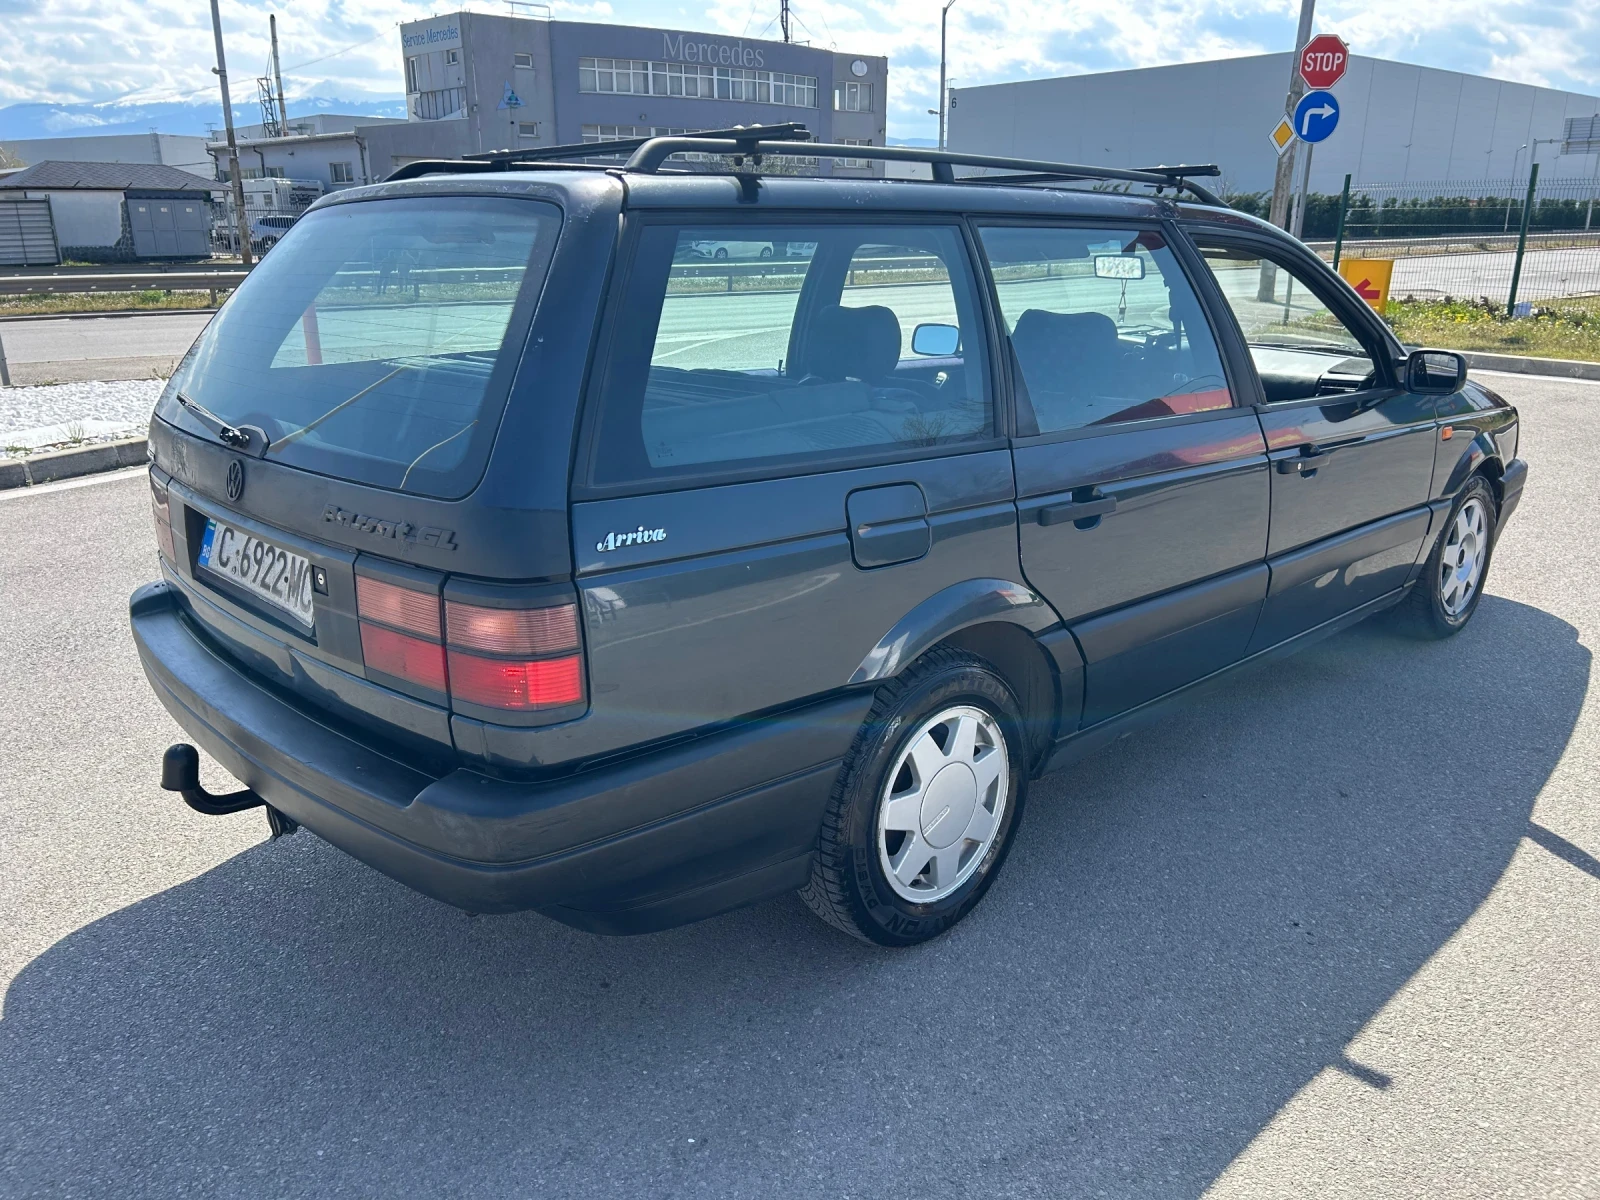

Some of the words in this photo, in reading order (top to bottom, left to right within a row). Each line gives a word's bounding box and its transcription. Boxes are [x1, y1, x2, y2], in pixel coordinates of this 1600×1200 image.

[402, 32, 426, 48] Service
[425, 25, 459, 44] Mercedes
[661, 32, 765, 68] Mercedes
[1304, 52, 1344, 72] STOP
[951, 97, 957, 109] 6
[596, 525, 667, 552] Arriva
